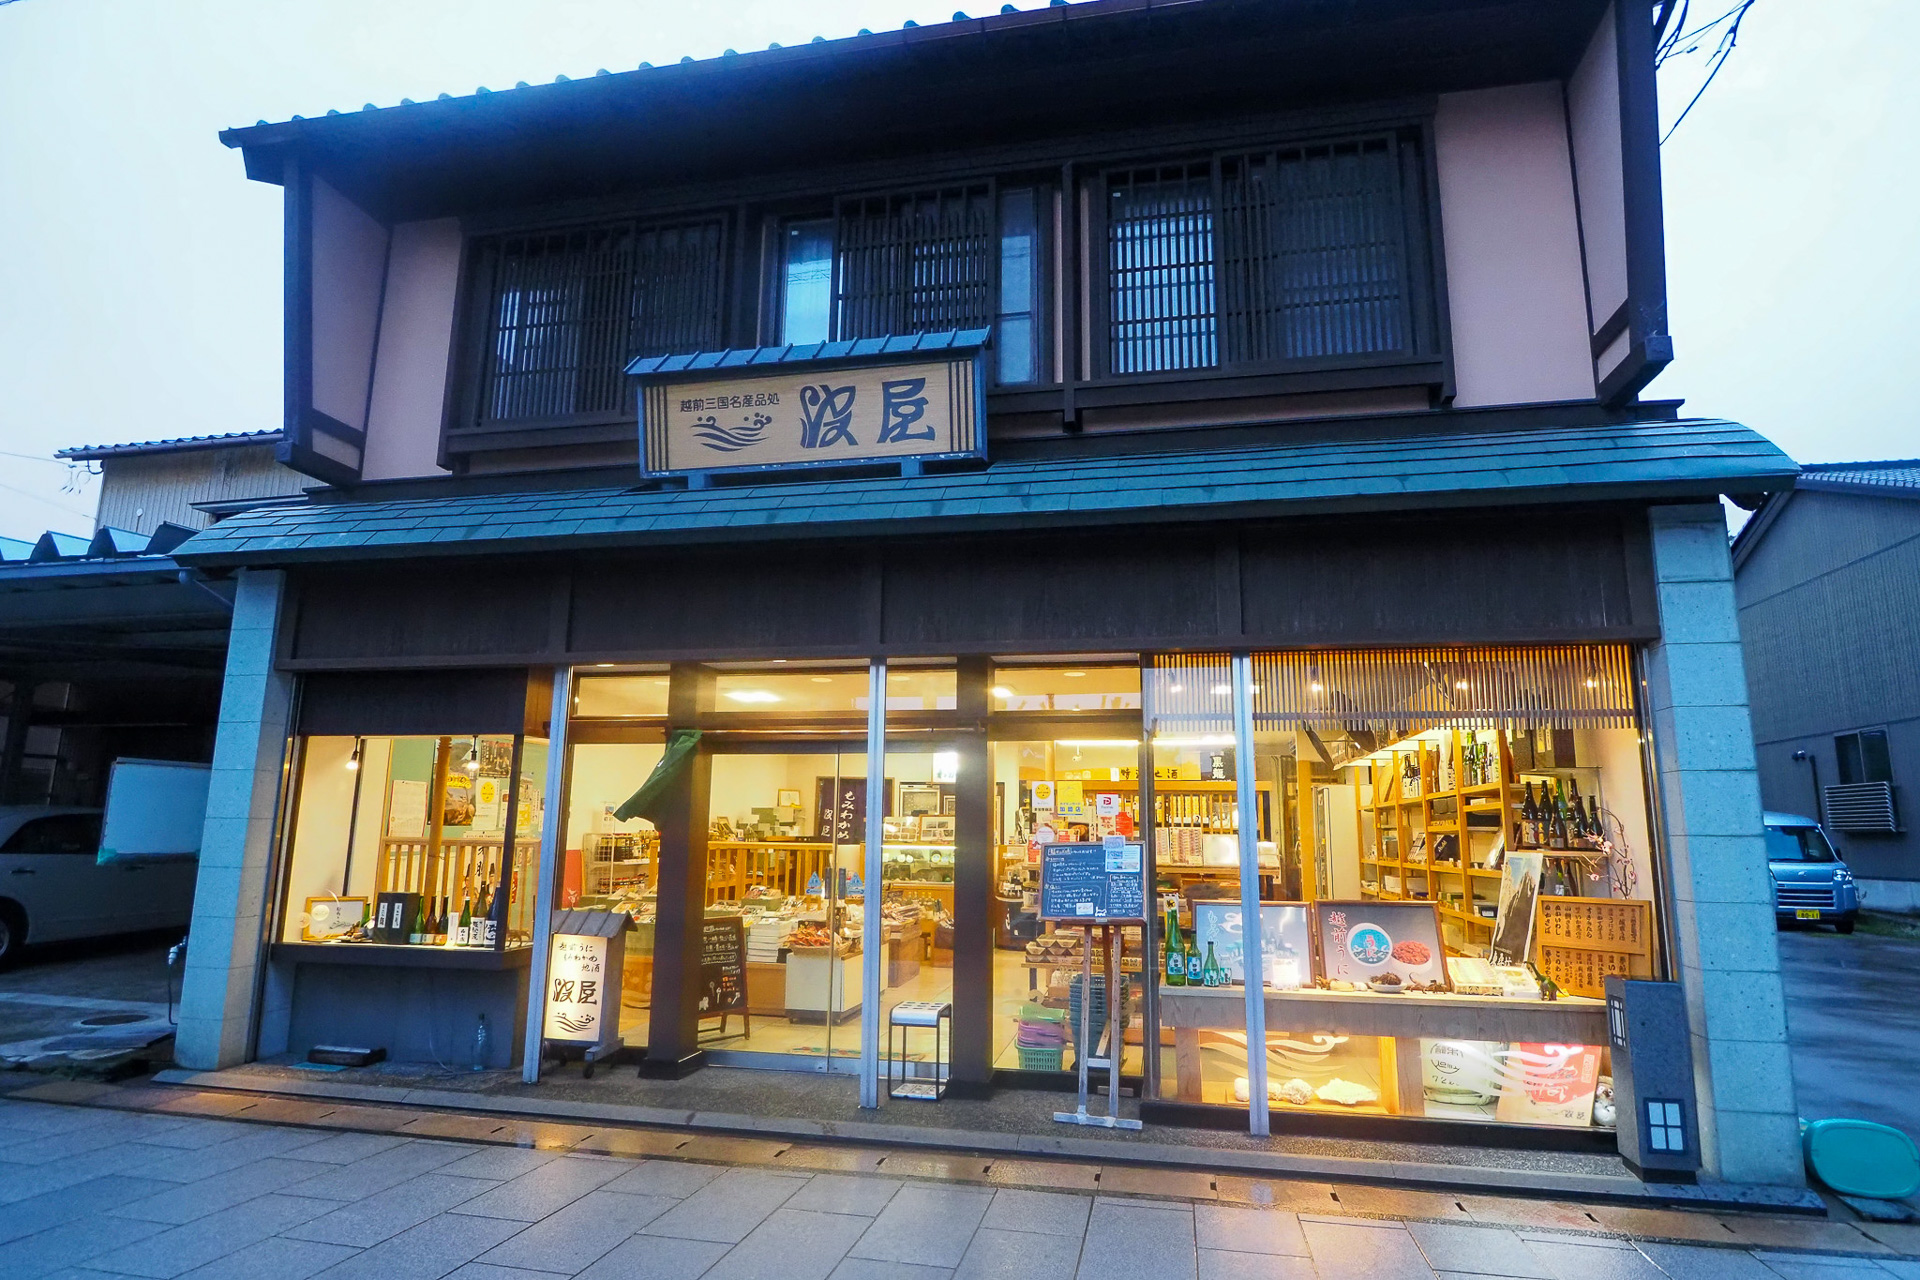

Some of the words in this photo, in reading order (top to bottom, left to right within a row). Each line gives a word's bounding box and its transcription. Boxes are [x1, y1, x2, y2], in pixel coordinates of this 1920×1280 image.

[680, 392, 780, 413] 越前三国名産品処
[837, 790, 856, 840] もみわかめ
[1327, 911, 1349, 975] 越前うに
